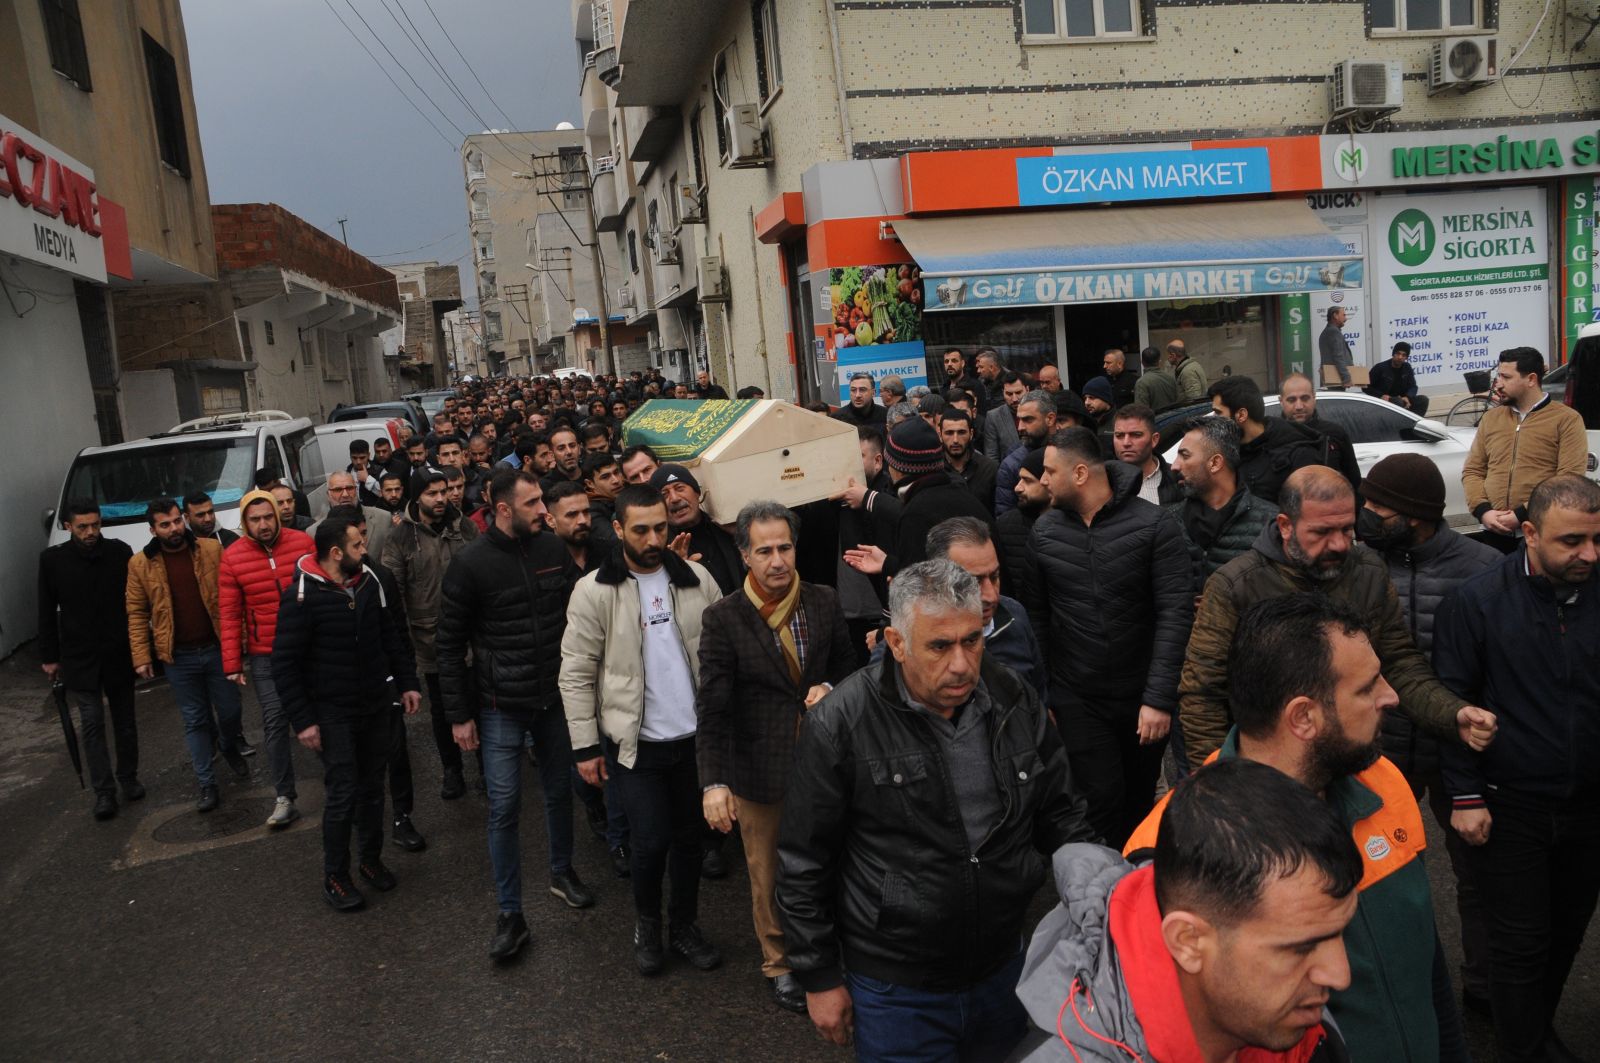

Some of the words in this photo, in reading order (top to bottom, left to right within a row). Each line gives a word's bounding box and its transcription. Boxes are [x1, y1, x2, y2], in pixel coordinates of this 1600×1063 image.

[1392, 135, 1564, 177] MERSİNA
[1572, 129, 1600, 167] S
[1042, 166, 1134, 194] ÖZKAN
[1142, 161, 1248, 189] MARKET
[1306, 192, 1355, 210] QUICK
[1442, 206, 1534, 234] MERSİNA
[33, 222, 78, 264] MEDYA
[1444, 236, 1536, 260] SİGORTA
[1035, 273, 1134, 302] ÖZKAN
[1144, 268, 1255, 298] MARKET
[1410, 276, 1440, 287] SİGORTA
[1441, 274, 1473, 284] ARACILIK
[1474, 271, 1513, 282] HİZMETLERİ
[972, 277, 1025, 299] Golf
[1430, 292, 1448, 300] 0555
[1450, 291, 1463, 299] 828
[1475, 289, 1484, 297] 06
[1490, 287, 1507, 296] 0555
[1508, 286, 1521, 294] 073
[1523, 285, 1532, 293] 57
[1533, 284, 1542, 292] 06
[1394, 315, 1429, 327] TRAFİK
[1454, 311, 1487, 322] KONUT
[1395, 328, 1428, 340] KASKO
[1455, 323, 1482, 334] FERDİ
[1484, 321, 1510, 332] KAZA
[1455, 335, 1489, 347] SAĞLIK
[1456, 349, 1465, 360] İŞ
[1467, 347, 1489, 358] YERİ
[880, 365, 919, 377] MARKET
